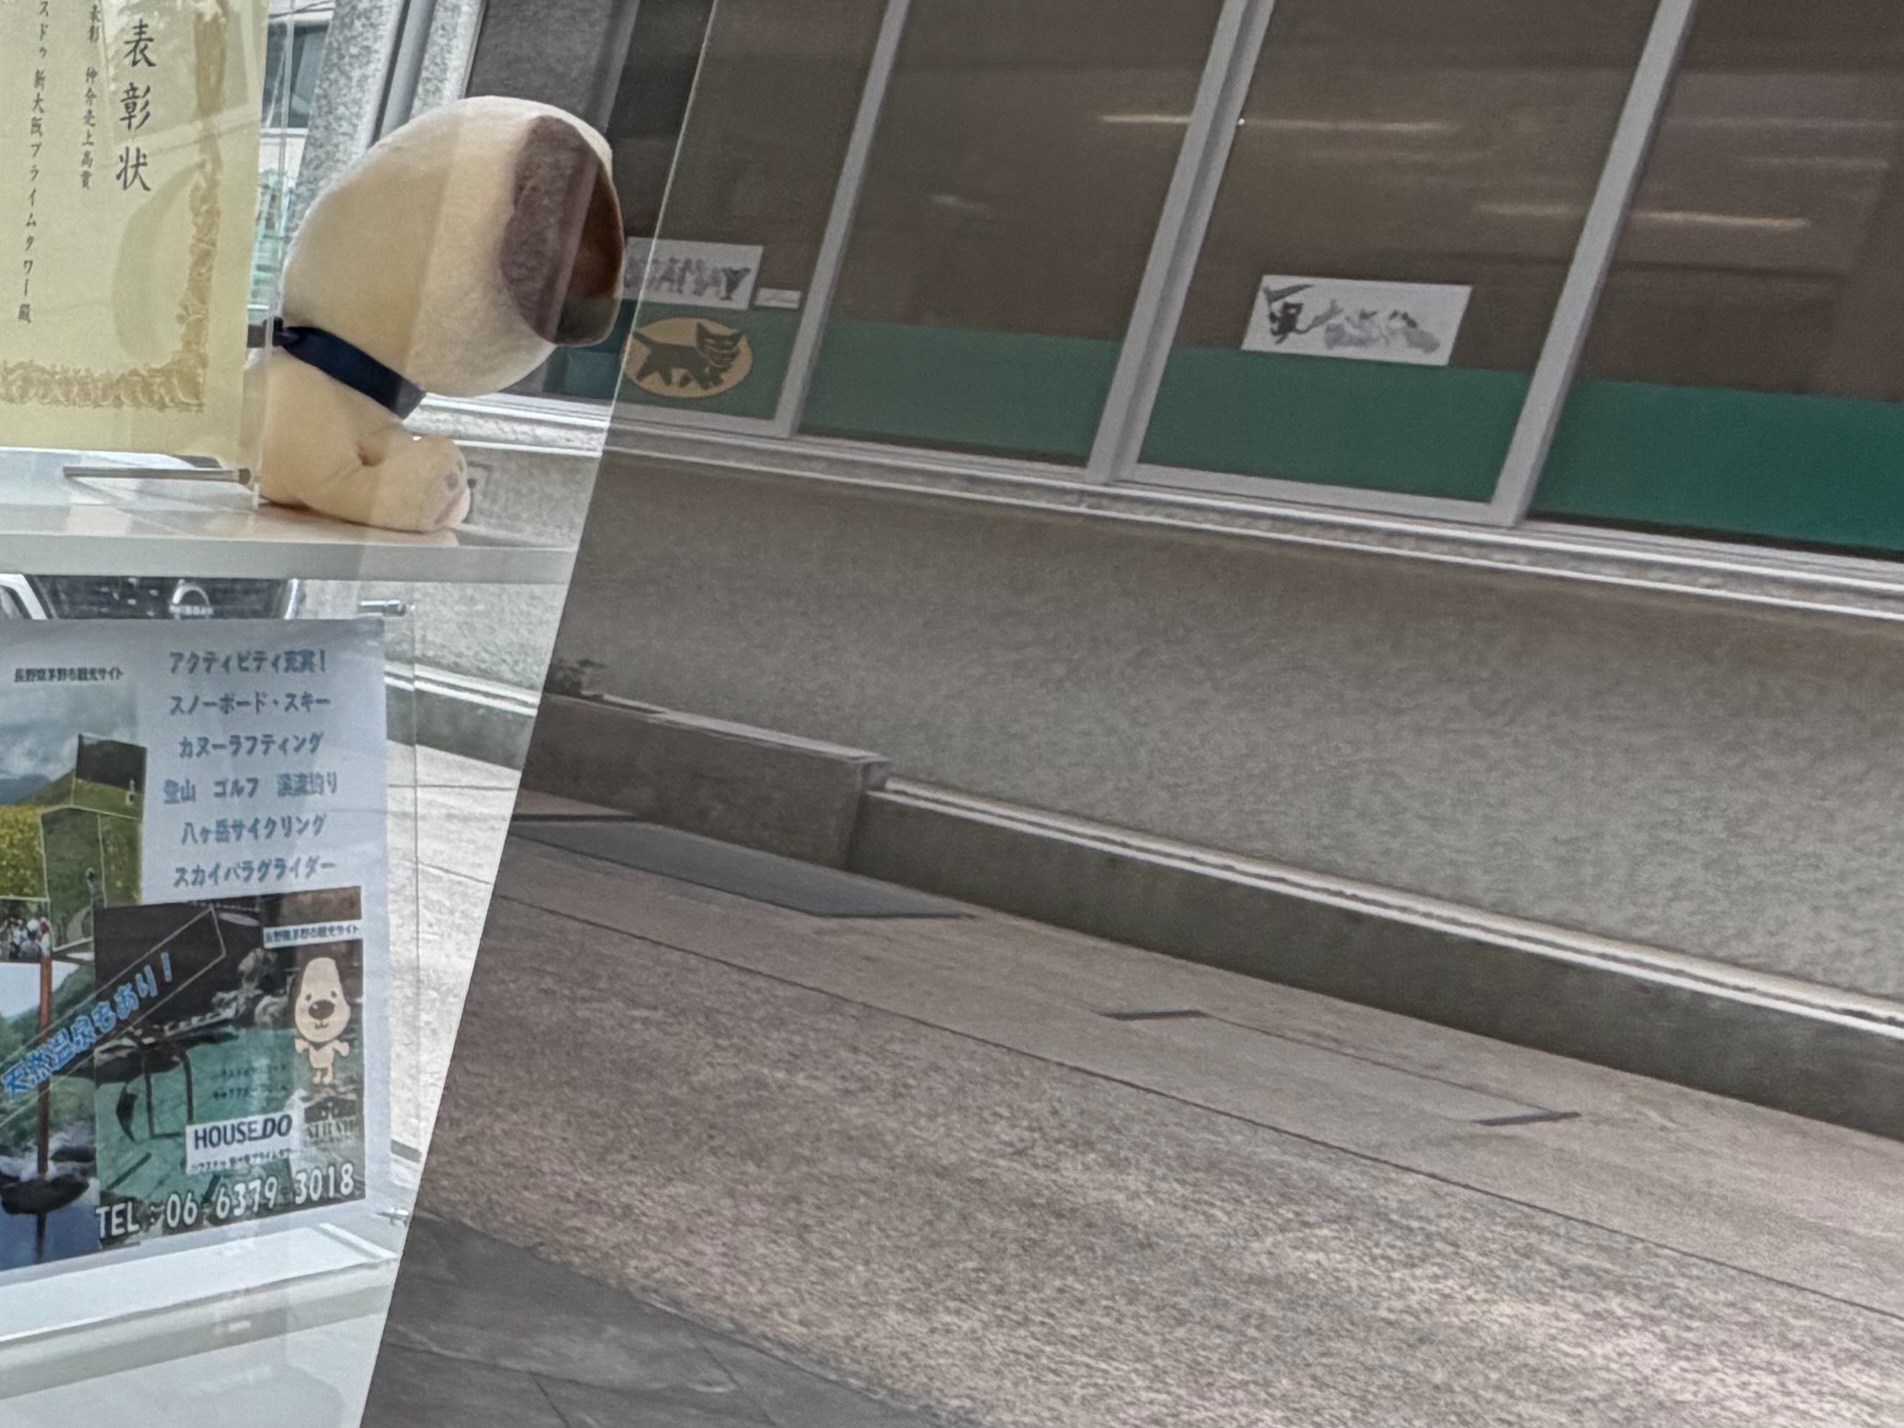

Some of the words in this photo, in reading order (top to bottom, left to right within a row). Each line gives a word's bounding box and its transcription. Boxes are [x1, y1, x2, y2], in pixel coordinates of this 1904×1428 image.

[115, 18, 158, 193] 表彰状
[167, 691, 332, 716] スノーボード・スキー
[178, 730, 325, 760] カヌーラフティング
[212, 776, 260, 799] ゴルフ
